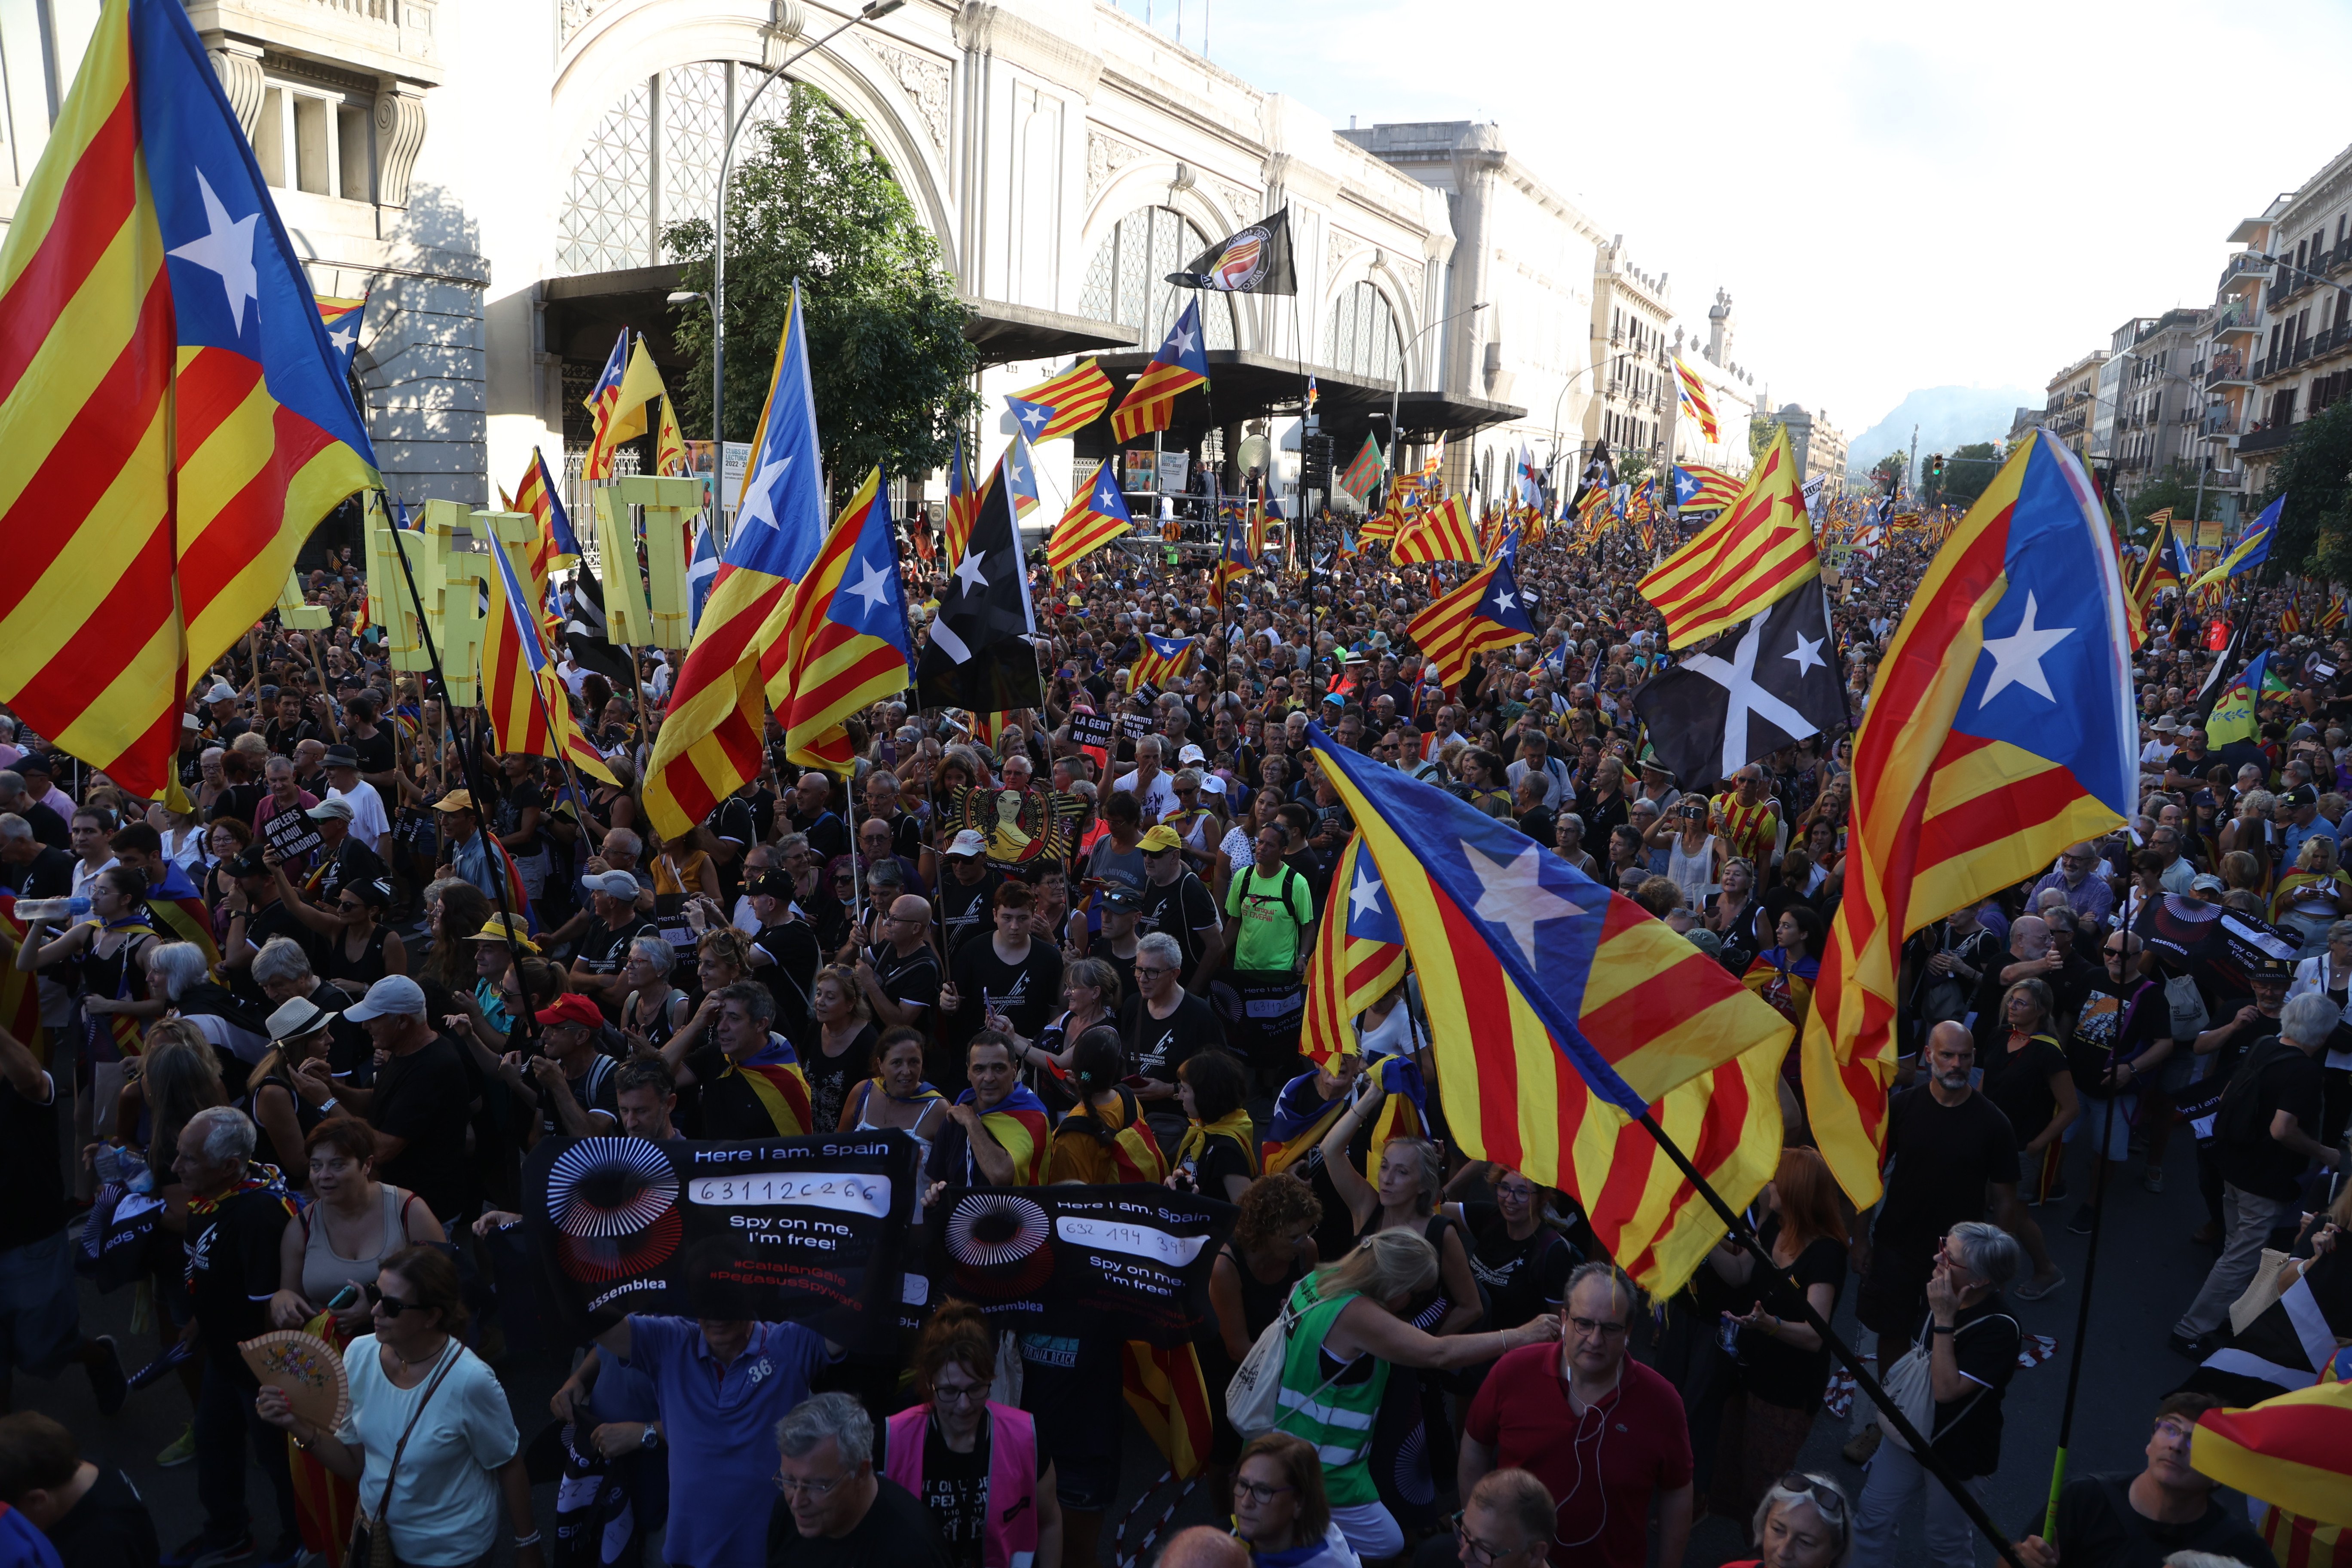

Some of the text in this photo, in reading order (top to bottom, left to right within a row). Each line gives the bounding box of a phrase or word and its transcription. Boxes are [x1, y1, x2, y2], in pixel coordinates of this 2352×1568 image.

[1285, 447, 1302, 460] ESTACI
[1291, 466, 1297, 477] DE
[1283, 482, 1299, 497] FRANÇ
[1142, 682, 1159, 698] OTIFLERS
[1075, 715, 1111, 732] LA GENT
[1130, 714, 1152, 725] PARTITS
[1073, 730, 1106, 746] HI SOM
[272, 822, 303, 848] NI AQUÍ
[402, 822, 413, 833] JO
[280, 848, 291, 859] A
[286, 831, 322, 856] MADRID
[2150, 937, 2189, 956] assemblea
[2226, 939, 2245, 952] Spy
[1262, 1022, 1276, 1033] Spy
[1278, 1017, 1290, 1026] on
[1268, 1029, 1281, 1037] I'm
[695, 1141, 889, 1163] Here I am, Spain
[1118, 1202, 1153, 1216] am,
[1158, 1207, 1211, 1224] Spain
[729, 1215, 854, 1239] Spy on me,
[749, 1232, 837, 1251] I'm free!
[1066, 1223, 1187, 1255] 632 194 399
[733, 1259, 847, 1288] #CatalanGate
[1090, 1255, 1186, 1287] Spy on me,
[709, 1270, 864, 1312] #PegasusSpyware
[1104, 1272, 1173, 1298] I'm free!
[587, 1278, 667, 1313] assemblea
[1050, 1351, 1076, 1365] BEACH
[748, 1359, 773, 1383] 36
